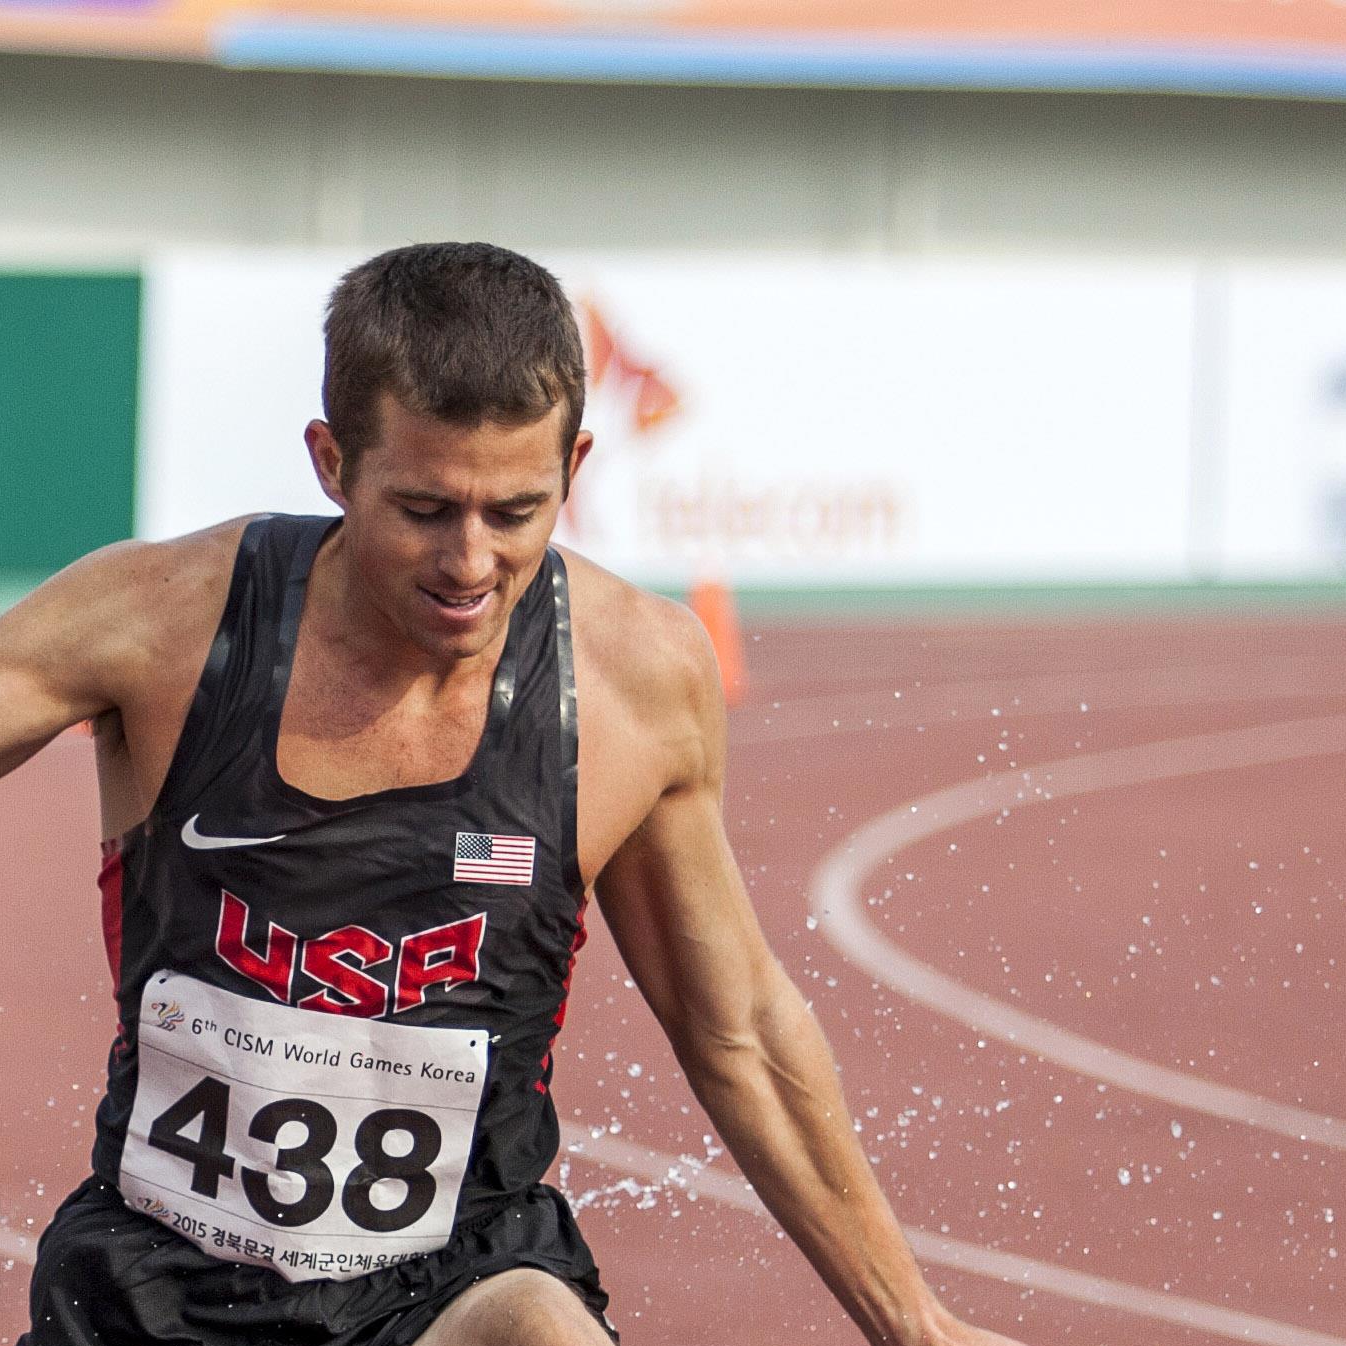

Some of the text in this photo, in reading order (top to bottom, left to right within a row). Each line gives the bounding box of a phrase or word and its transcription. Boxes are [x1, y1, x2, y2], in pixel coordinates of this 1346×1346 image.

[215, 887, 488, 1019] USA
[190, 1017, 476, 1084] 6th CISM World Games Korea
[147, 1075, 442, 1233] 438
[172, 1211, 207, 1239] 2015
[211, 1226, 275, 1263] 경북문경
